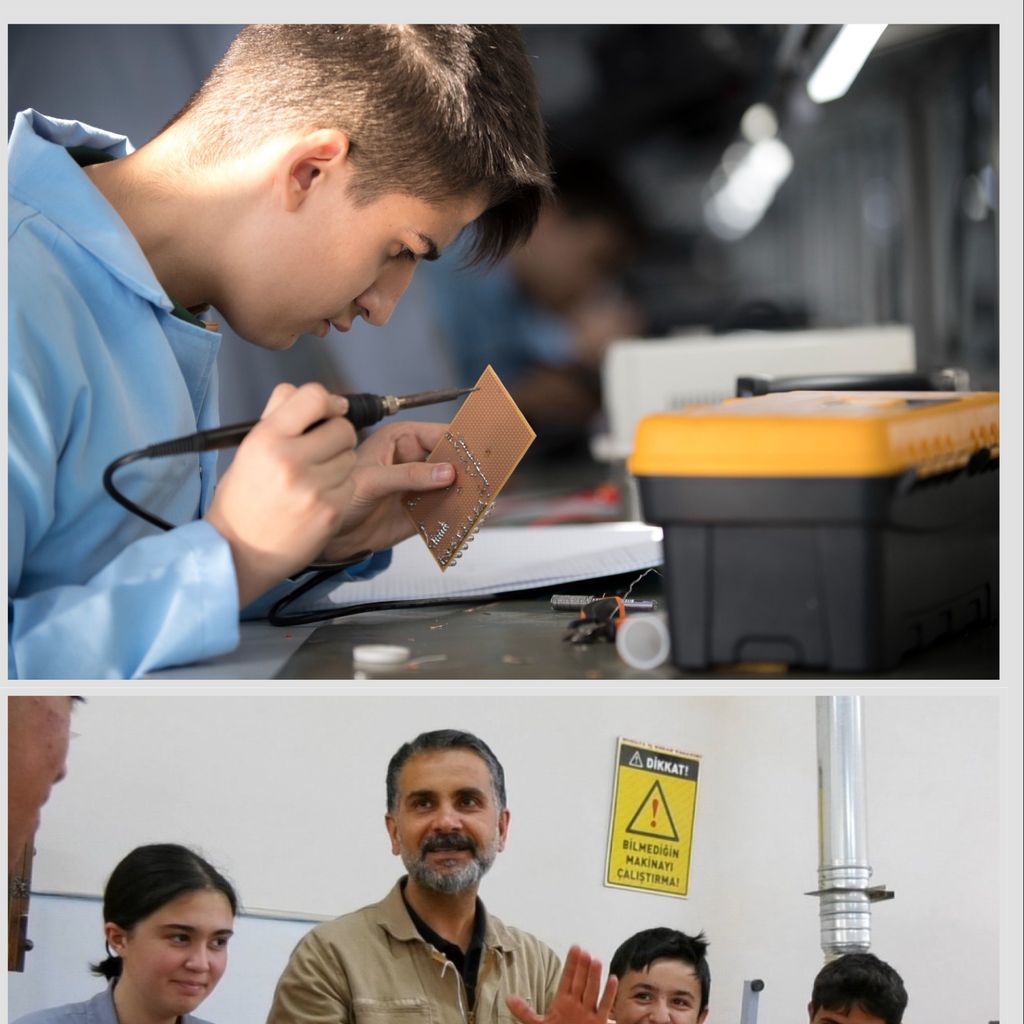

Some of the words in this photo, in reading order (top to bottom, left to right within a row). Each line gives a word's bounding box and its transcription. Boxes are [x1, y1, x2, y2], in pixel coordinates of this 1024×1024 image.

[646, 757, 690, 776] DİKKAT!
[623, 839, 679, 858] BİLMEDİĞİN
[626, 855, 674, 871] MAKİNAYI
[617, 869, 680, 887] ÇALIŞTIRMA!
